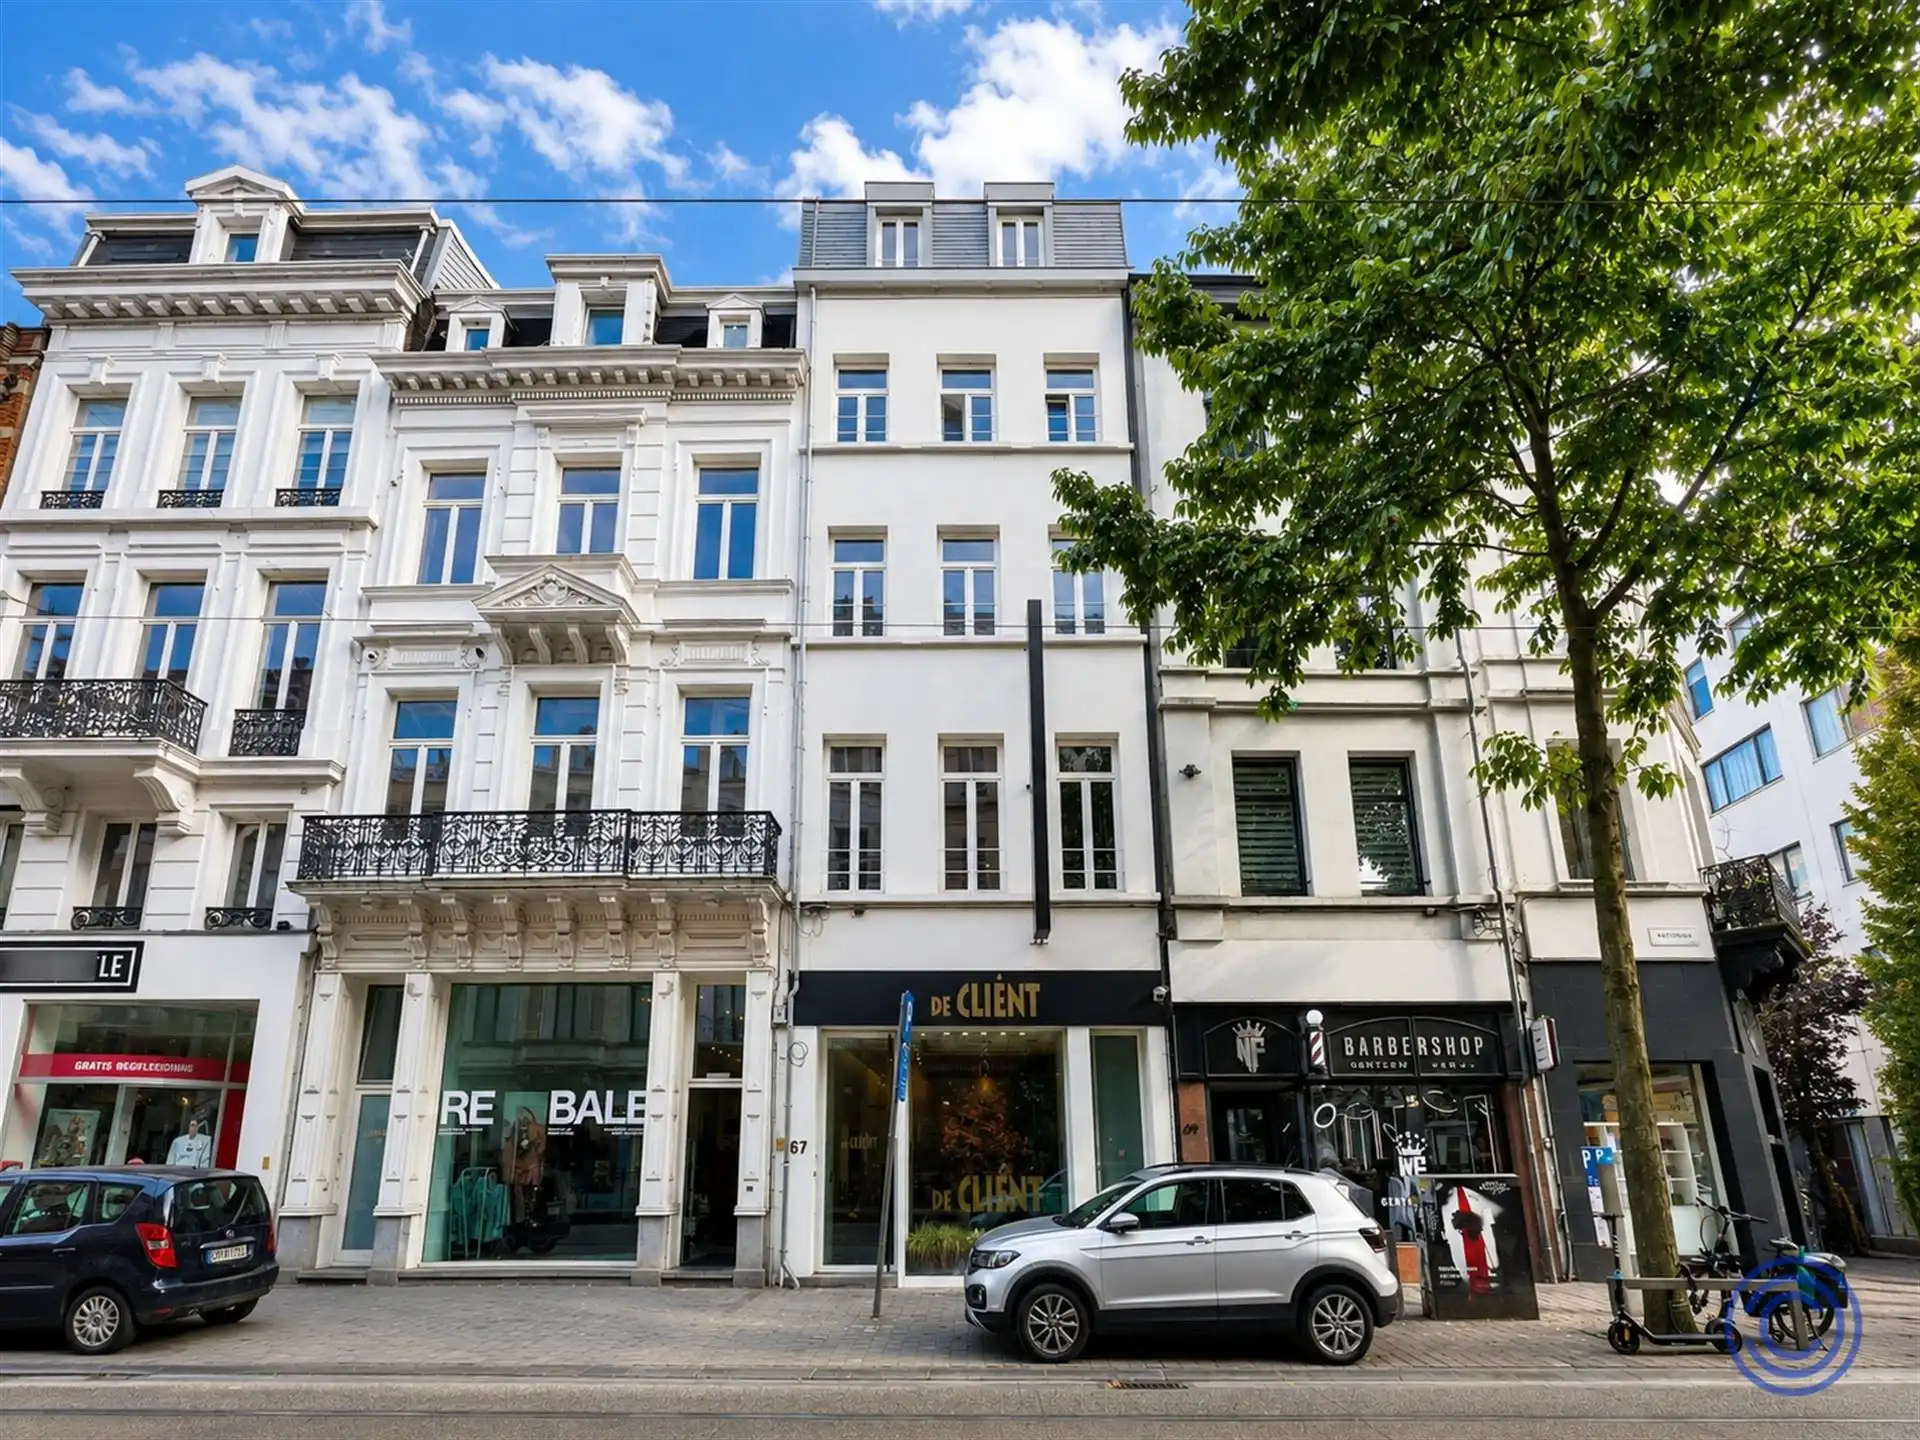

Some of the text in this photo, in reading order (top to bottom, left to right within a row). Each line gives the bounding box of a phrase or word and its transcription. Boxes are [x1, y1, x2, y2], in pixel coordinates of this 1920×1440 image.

[931, 995, 951, 1017] DE
[1344, 1036, 1484, 1057] BARBERSHOP
[74, 1061, 112, 1071] GRATIS
[440, 1090, 496, 1125] RE
[790, 1140, 808, 1155] 67
[1595, 1149, 1604, 1161] P
[1582, 1150, 1591, 1169] P
[932, 1189, 952, 1212] DE
